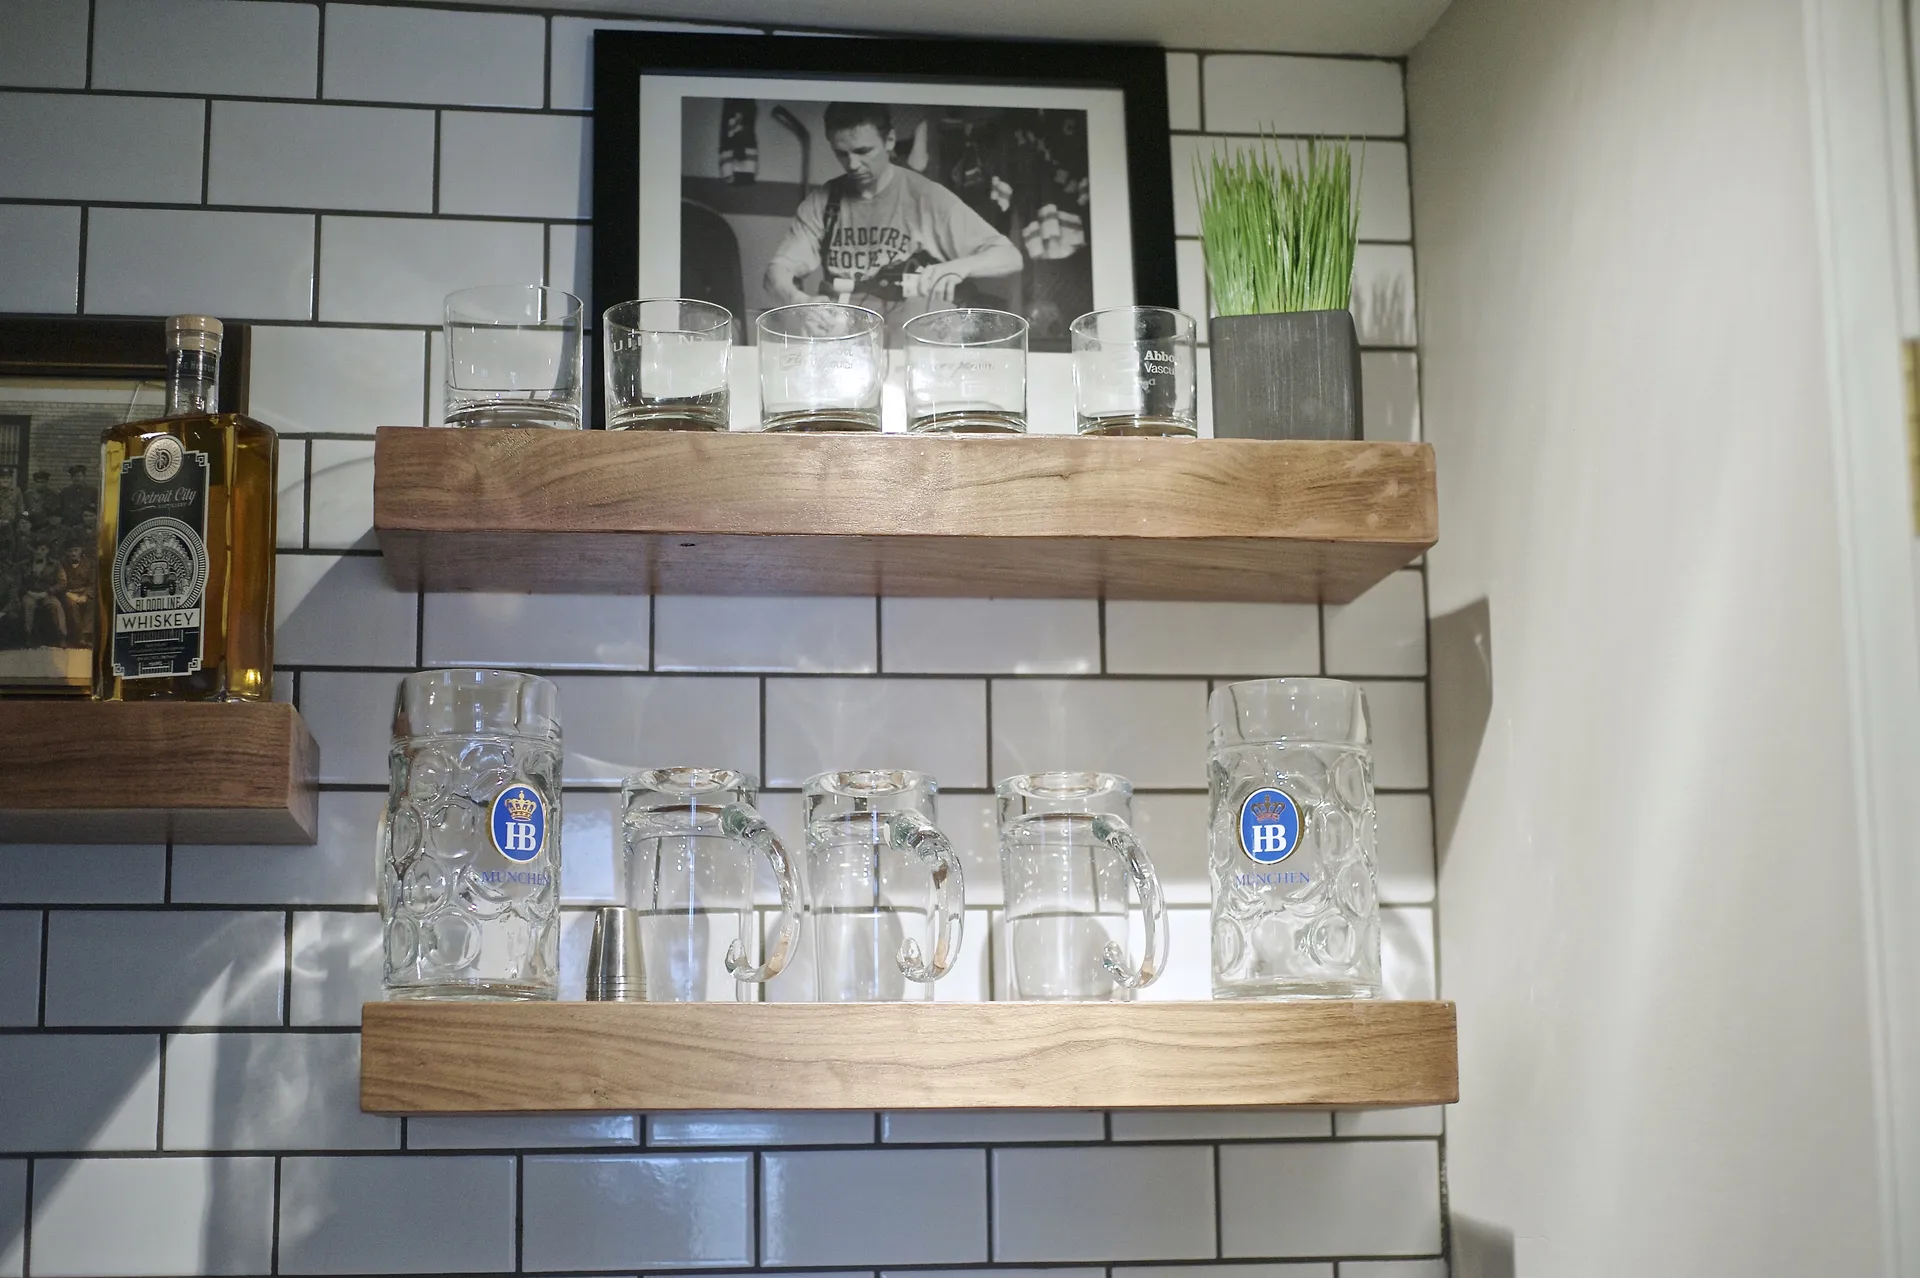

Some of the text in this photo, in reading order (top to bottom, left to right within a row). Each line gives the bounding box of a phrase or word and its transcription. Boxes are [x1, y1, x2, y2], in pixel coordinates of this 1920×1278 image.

[831, 227, 911, 253] ARDCRE
[1143, 350, 1175, 363] Abbo
[1143, 362, 1175, 375] Vascu
[131, 486, 197, 506] Detroit City
[122, 612, 194, 629] WHISKEY
[504, 821, 537, 851] HB
[1252, 824, 1287, 853] HB
